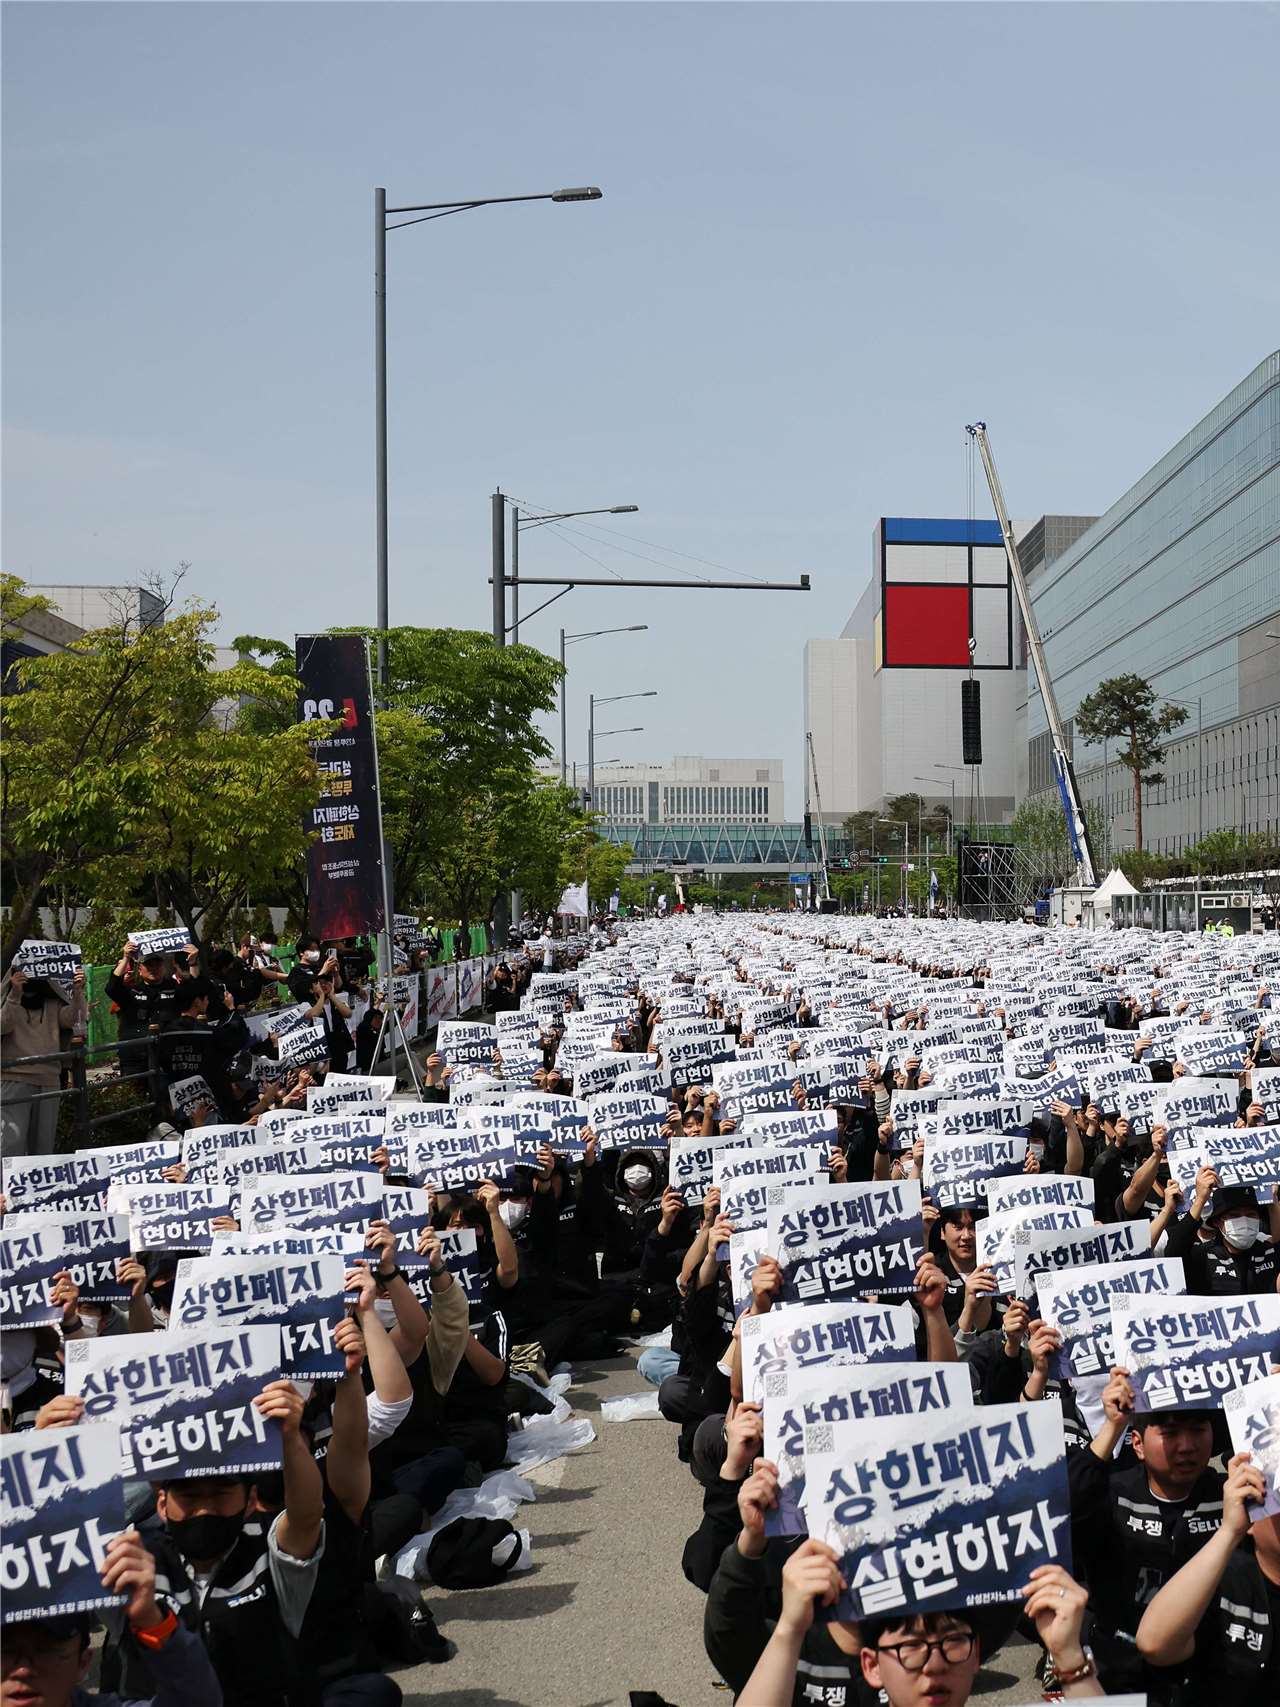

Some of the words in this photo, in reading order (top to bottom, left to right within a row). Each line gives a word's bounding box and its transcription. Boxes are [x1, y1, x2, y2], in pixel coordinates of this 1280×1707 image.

[140, 935, 190, 953] 실현하자
[21, 961, 81, 977] 실현하자
[281, 1029, 318, 1055] 상한폐지
[442, 1026, 492, 1042] 상한폐지
[1048, 1021, 1098, 1041] 상한폐지
[668, 1038, 726, 1063] 상한폐지
[578, 1059, 632, 1087] 상한폐지
[717, 1065, 788, 1091] 상한폐지
[1004, 1072, 1064, 1094] 상한폐지
[1093, 1065, 1147, 1090] 상한폐지
[592, 1100, 656, 1122] 상한폐지
[725, 1089, 794, 1117] 실현하자
[1164, 1093, 1230, 1120] 상한폐지
[291, 1119, 371, 1142] 상한폐지
[943, 1105, 1022, 1135] 상한폐지
[187, 1129, 256, 1161] 상한폐지
[415, 1131, 500, 1161] 상한폐지
[1205, 1128, 1280, 1156] 상한폐지
[930, 1140, 1014, 1173] 상한폐지
[8, 1158, 98, 1197] 상한폐지
[423, 1159, 515, 1191] 실현하자
[250, 1177, 365, 1222] 상한폐지
[778, 1186, 904, 1248] 상한폐지
[793, 1239, 924, 1300] 실현하자
[180, 1261, 321, 1323] 상한폐지
[899, 1285, 923, 1294] 공동투쟁
[1052, 1263, 1169, 1326] 상한폐지
[1126, 1301, 1261, 1354] 상한폐지
[753, 1311, 896, 1373] 상한폐지
[80, 1333, 254, 1416] 상한폐지
[1142, 1352, 1273, 1409] 실현하자
[777, 1370, 951, 1457] 상한폐지
[824, 1411, 1035, 1525] 상한폐지
[1126, 1515, 1162, 1535] 투쟁
[1188, 1518, 1223, 1533] SELU
[0, 1518, 124, 1590] 하자
[851, 1500, 1070, 1616] 실현하자
[966, 1588, 1023, 1606] 삼성전자노동조
[1225, 1623, 1263, 1648] 투쟁
[804, 1683, 846, 1707] 투쟁
